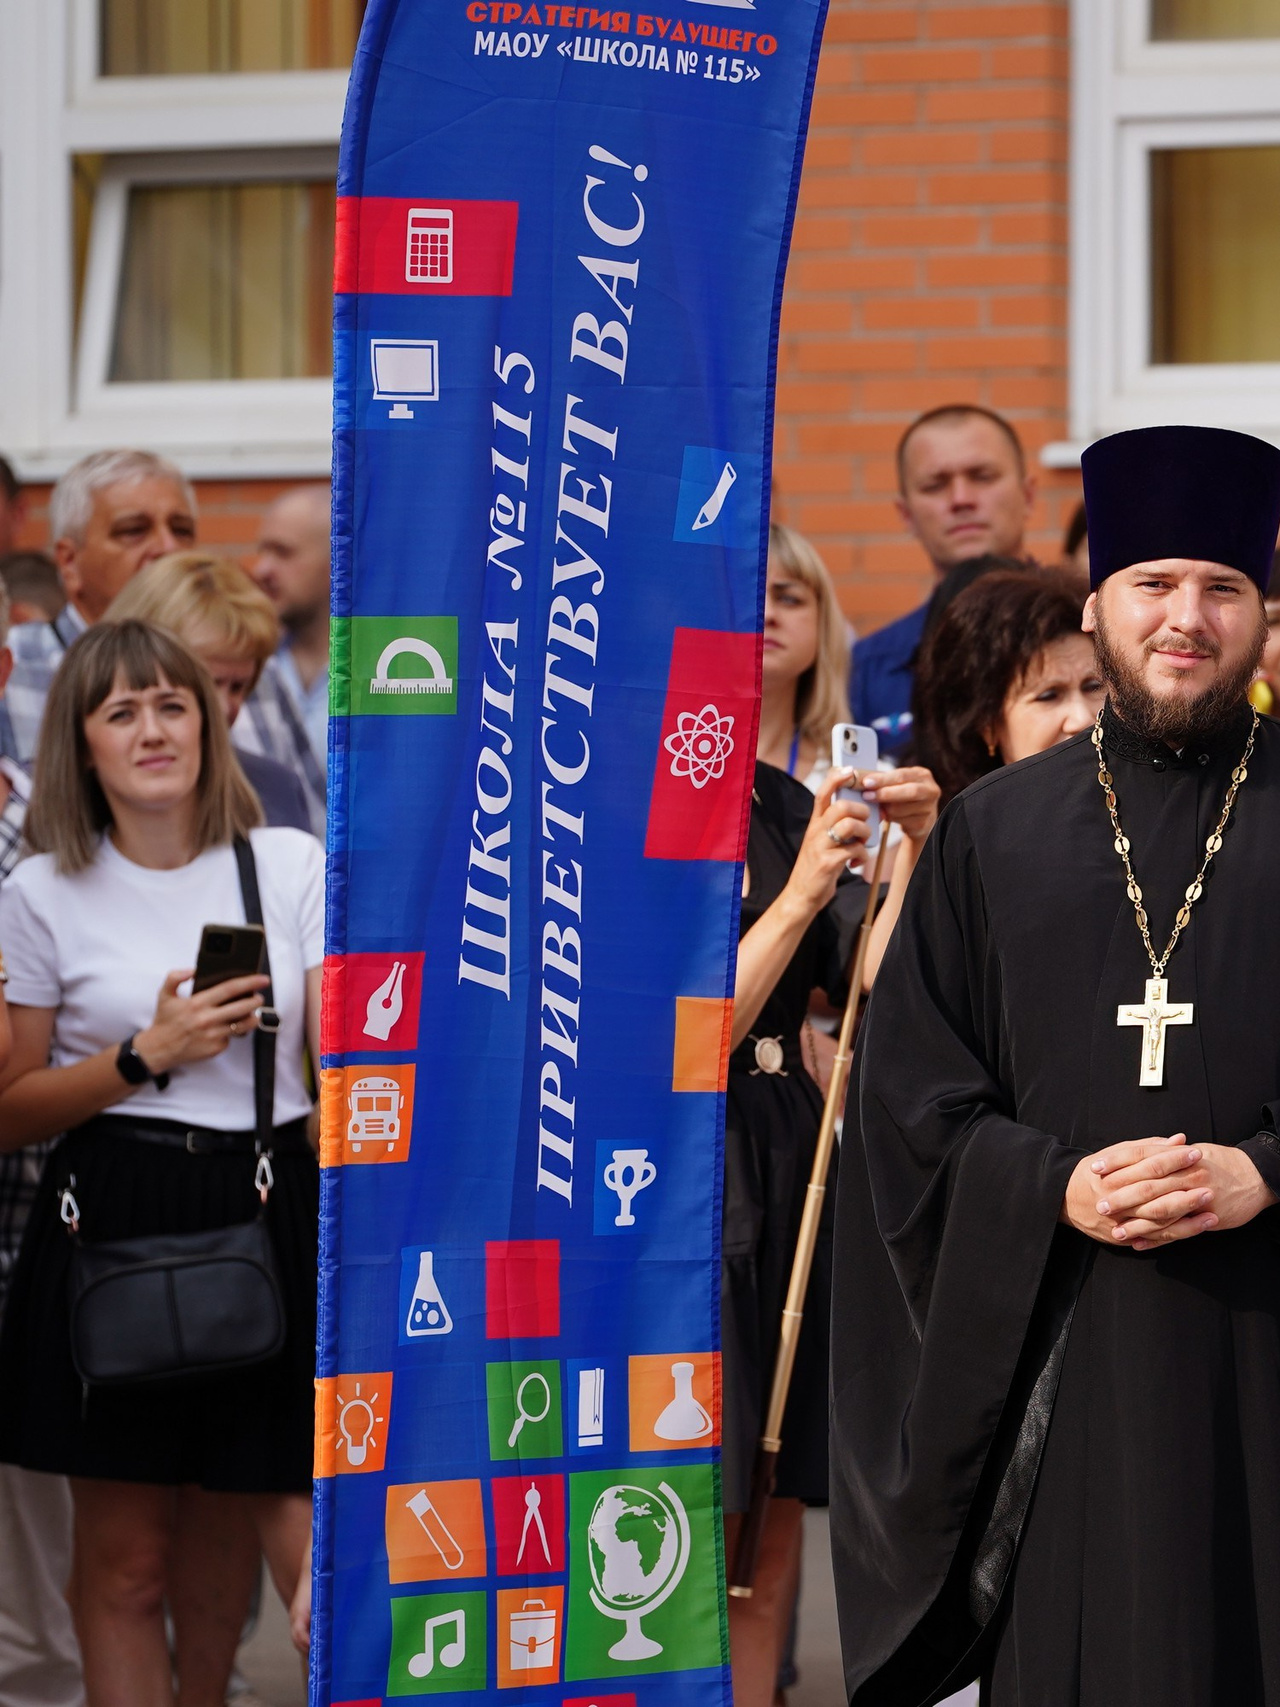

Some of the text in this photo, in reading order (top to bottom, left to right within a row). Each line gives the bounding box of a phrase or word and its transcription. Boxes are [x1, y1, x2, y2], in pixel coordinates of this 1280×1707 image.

[466, 1, 778, 56] СТРАТЕГИЯ БУДУЩЕГО
[474, 30, 550, 58] МАОУ
[556, 36, 670, 72] «ШКОЛА
[536, 144, 649, 1209] ПРИВЕТСТВУЕТ ВАС!
[457, 618, 519, 1001] ШКОЛА
